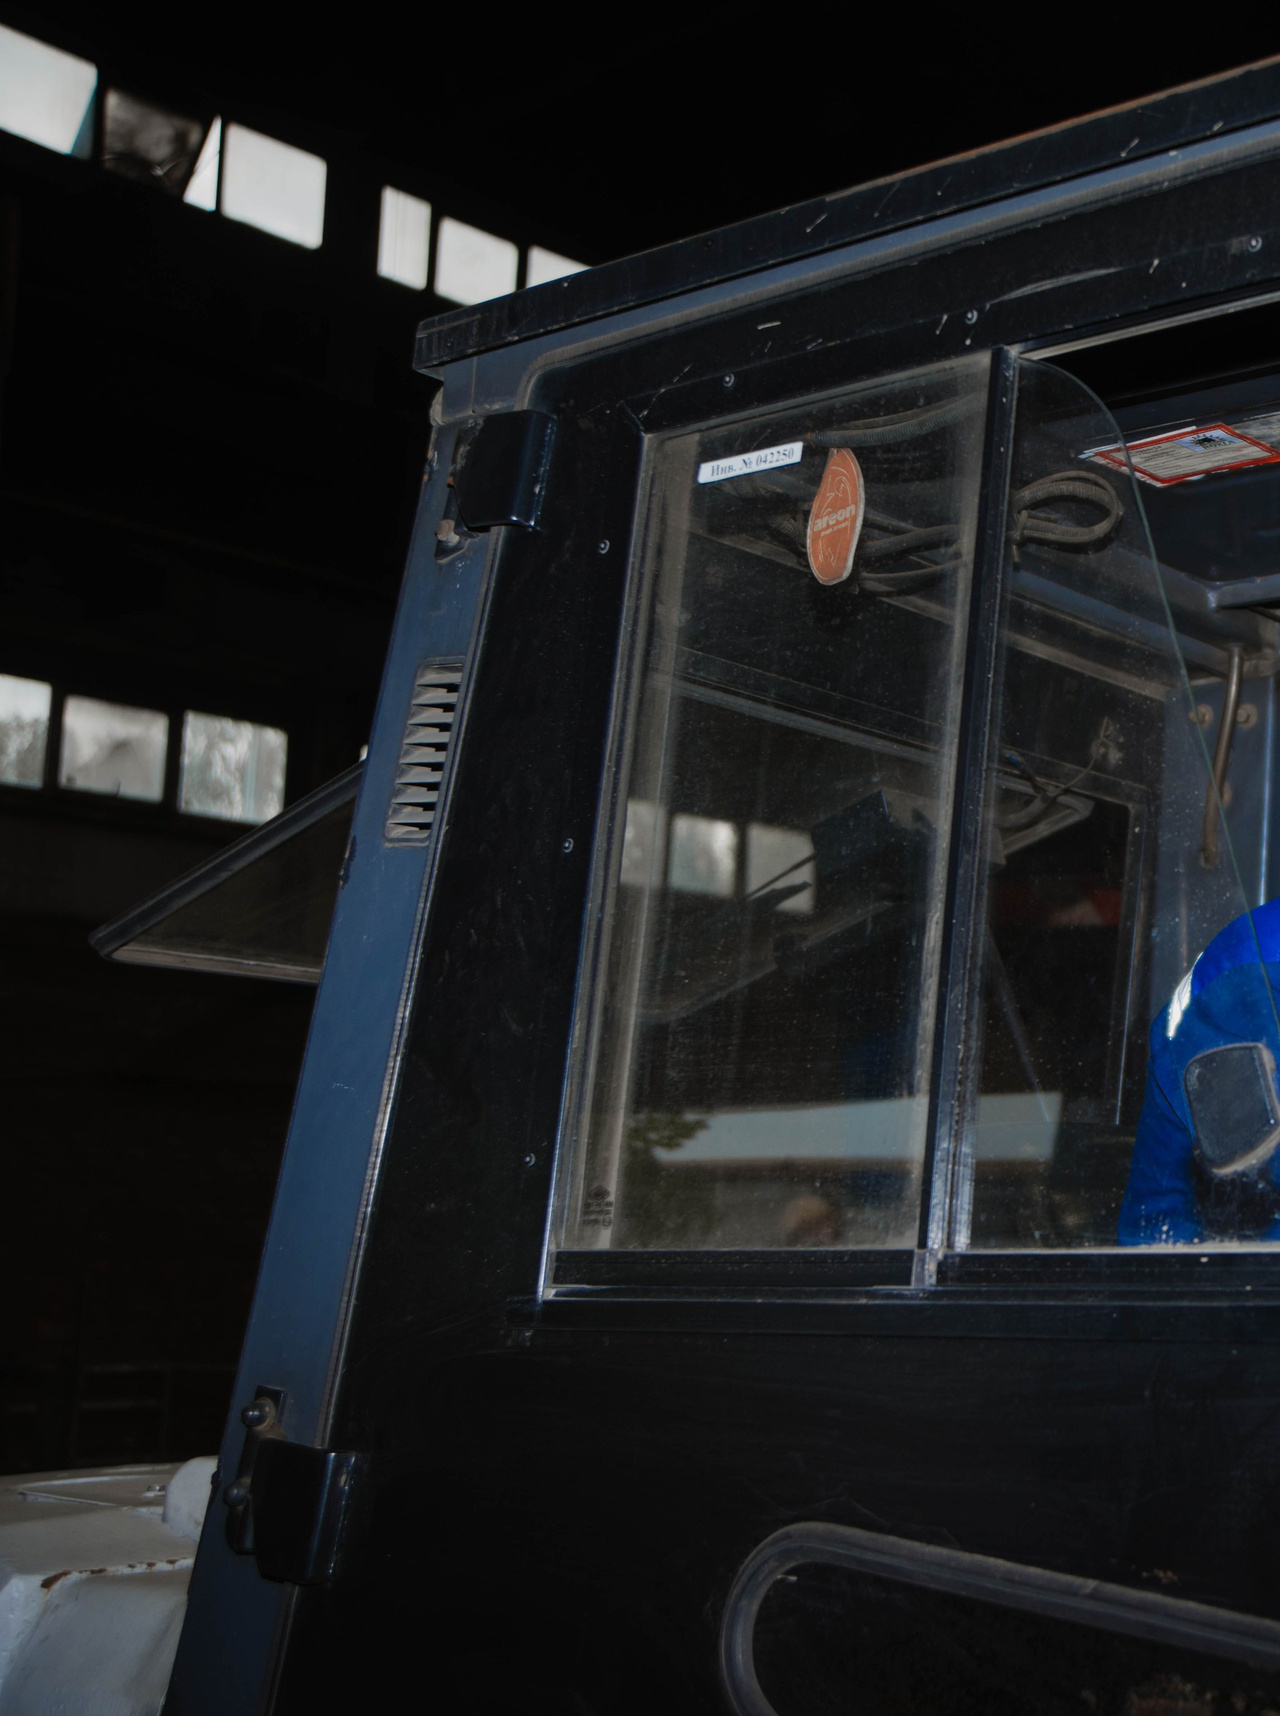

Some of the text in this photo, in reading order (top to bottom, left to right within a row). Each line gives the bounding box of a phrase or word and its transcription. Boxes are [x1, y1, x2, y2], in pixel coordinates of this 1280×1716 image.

[711, 447, 794, 477] Инв. № 042250
[814, 504, 855, 532] areon
